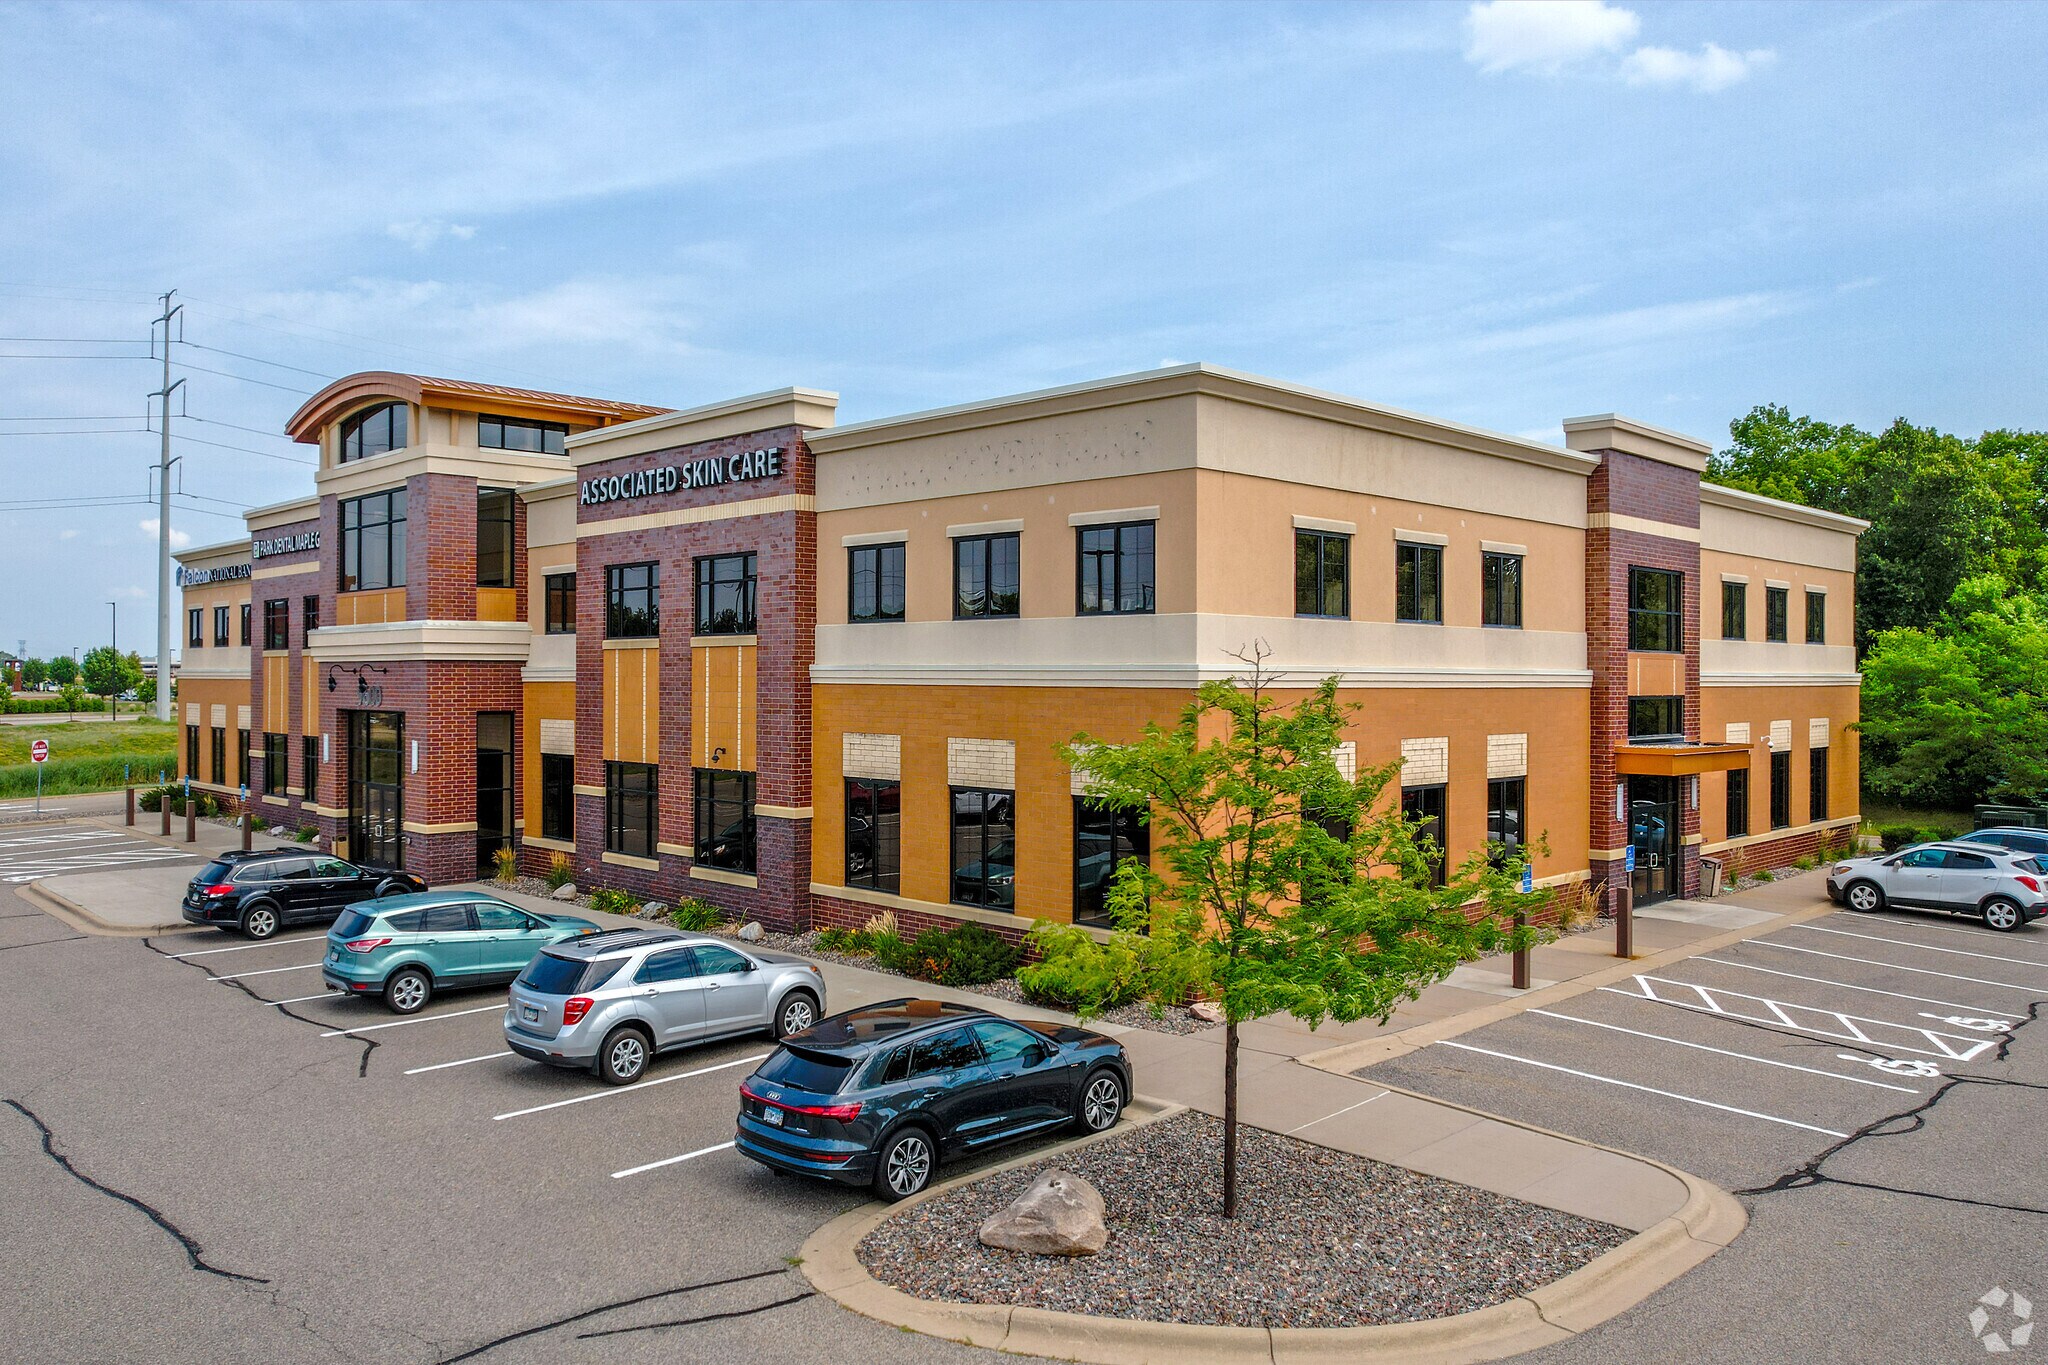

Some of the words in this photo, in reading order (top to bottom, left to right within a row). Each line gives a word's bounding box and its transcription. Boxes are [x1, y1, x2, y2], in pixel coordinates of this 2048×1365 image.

[580, 465, 679, 505] ASSOCIATED
[682, 456, 724, 490] SKIN
[728, 447, 780, 482] CARE
[260, 538, 274, 556] PARK
[274, 535, 295, 554] DENTAL
[295, 532, 315, 551] MAPLE
[184, 568, 209, 585] Falcon
[209, 565, 237, 582] NATIONAL
